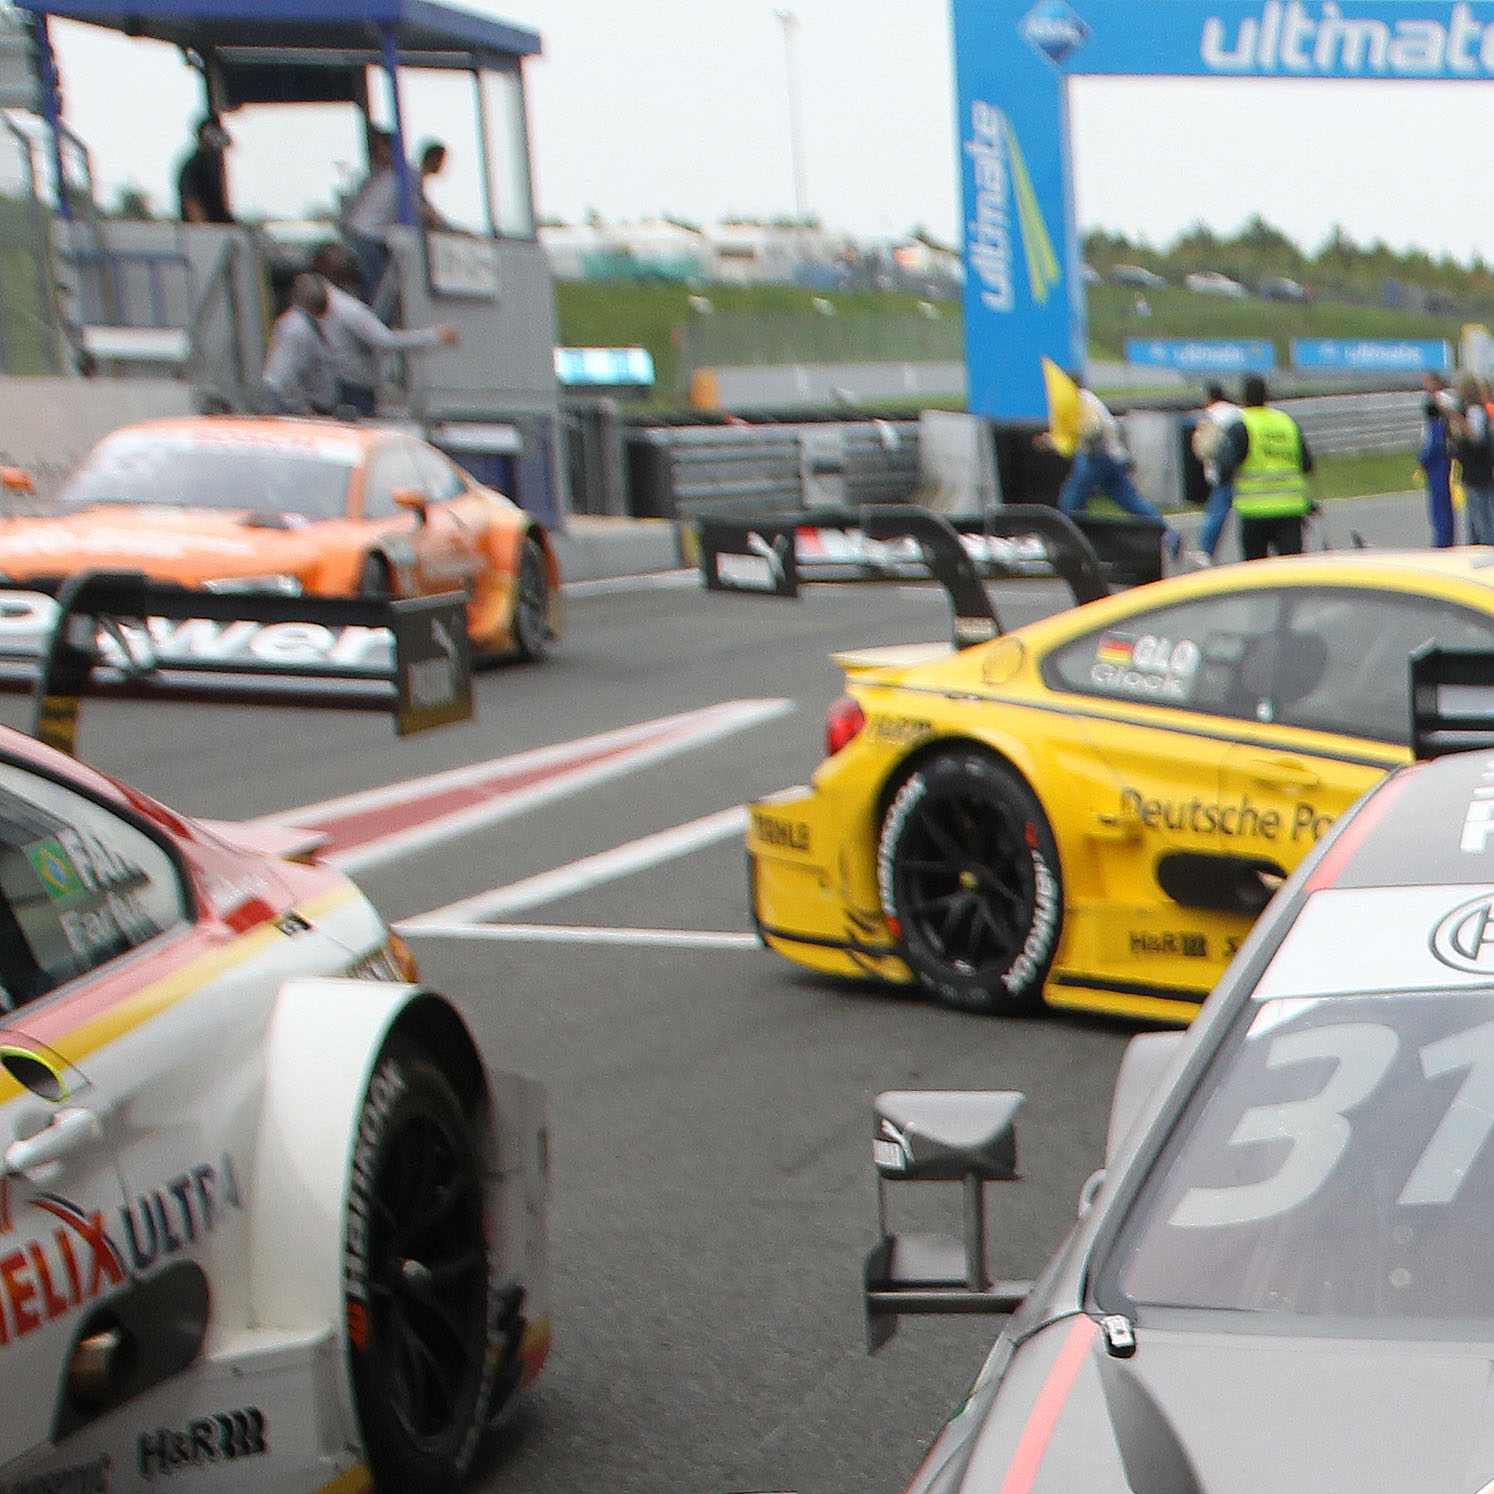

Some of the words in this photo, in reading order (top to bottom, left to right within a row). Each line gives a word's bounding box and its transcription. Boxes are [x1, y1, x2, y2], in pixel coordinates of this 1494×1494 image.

[965, 100, 1012, 312] ultimate
[1121, 786, 1281, 840] Deutsche
[1291, 802, 1336, 841] Po
